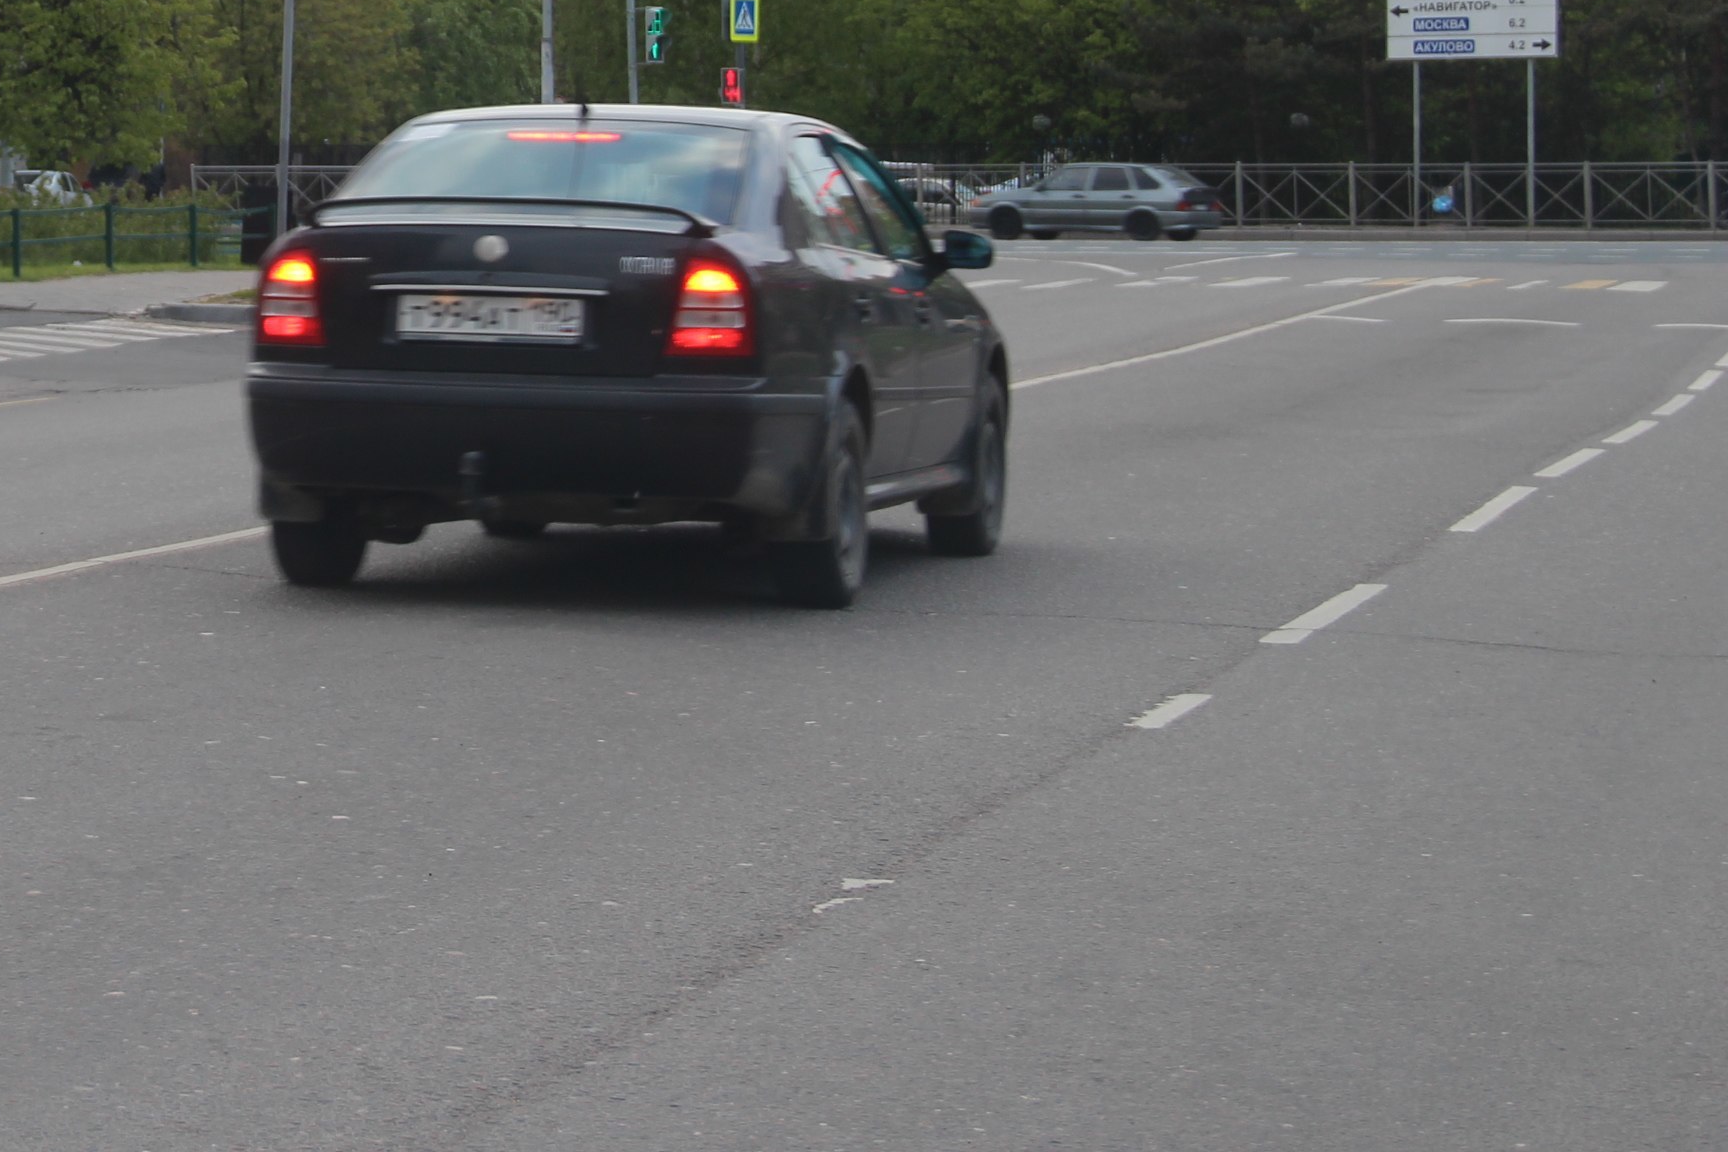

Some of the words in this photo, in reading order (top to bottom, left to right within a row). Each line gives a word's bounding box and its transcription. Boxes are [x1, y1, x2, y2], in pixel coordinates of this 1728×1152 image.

[1415, 19, 1467, 30] МОСКВА
[1414, 40, 1473, 53] АКУЛОВО
[1508, 39, 1526, 50] 4.2
